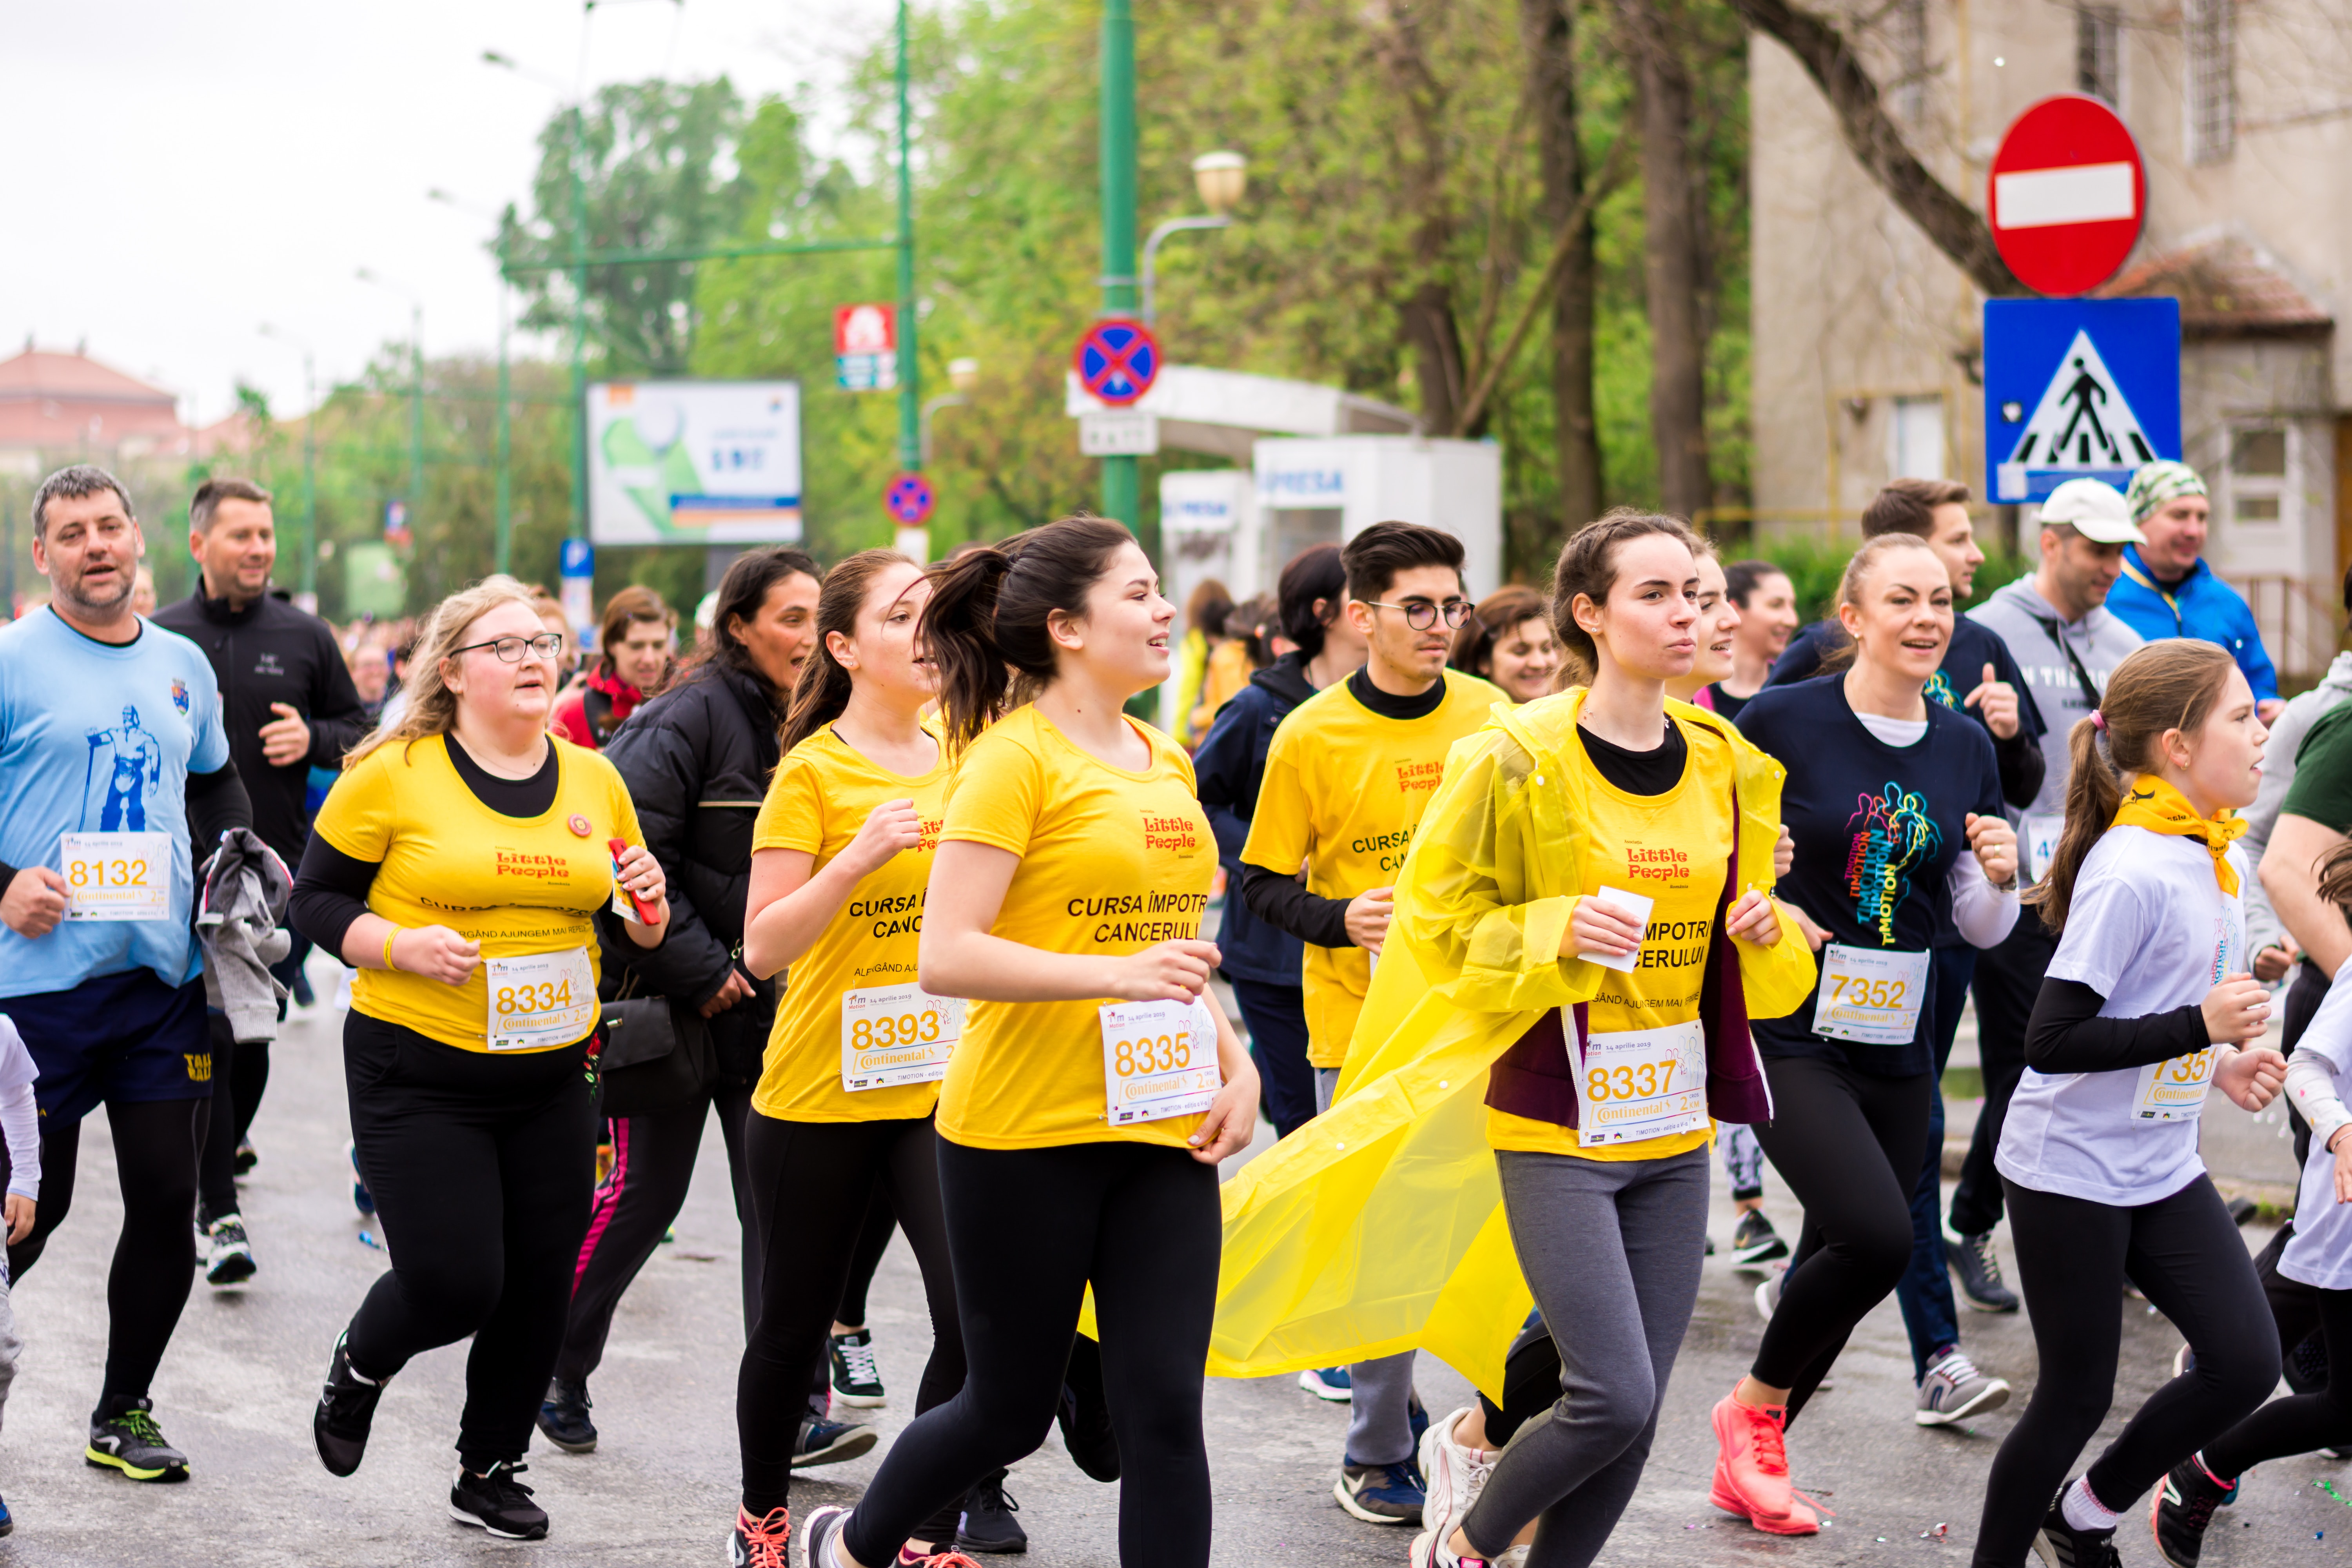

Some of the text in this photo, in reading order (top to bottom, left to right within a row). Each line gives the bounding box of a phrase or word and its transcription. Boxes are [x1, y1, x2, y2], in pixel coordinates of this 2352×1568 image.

[1142, 817, 1193, 832] Little
[1145, 833, 1195, 851] People
[1352, 830, 1409, 853] CURSA
[496, 852, 566, 866] Little
[1626, 848, 1688, 862] Little
[1844, 833, 1861, 880] TIMOTION
[1849, 831, 1871, 897] TIMOTION
[70, 859, 147, 887] 8132
[496, 864, 569, 879] People
[1628, 864, 1690, 881] People
[77, 890, 134, 903] Continental
[849, 894, 916, 917] CURSA
[1067, 895, 1143, 916] CURSA
[1878, 864, 1896, 946] TIMOTION
[501, 929, 550, 938] AJUNGEM
[496, 978, 572, 1015] 8334
[1830, 974, 1906, 1009] 7352
[1624, 996, 1663, 1009] AJUNGEM
[1666, 998, 1682, 1007] MAI
[503, 1013, 560, 1031] Continental
[574, 1009, 580, 1022] 2
[1136, 1013, 1152, 1021] aprilie
[1831, 1007, 1889, 1022] Continental
[1902, 1013, 1908, 1025] 2
[851, 1010, 940, 1051] 8393
[860, 1045, 955, 1069] Continental 2
[1115, 1032, 1191, 1077] 8335
[1125, 1076, 1179, 1100] Continental
[1196, 1073, 1205, 1089] 2
[1587, 1059, 1676, 1102] 8337
[1690, 1100, 1699, 1109] KM
[2154, 1086, 2203, 1102] Continental
[1160, 1105, 1181, 1113] TIMOTION
[1597, 1101, 1662, 1123] Continental
[1680, 1096, 1688, 1111] 2
[1636, 1127, 1660, 1136] TIMOTION
